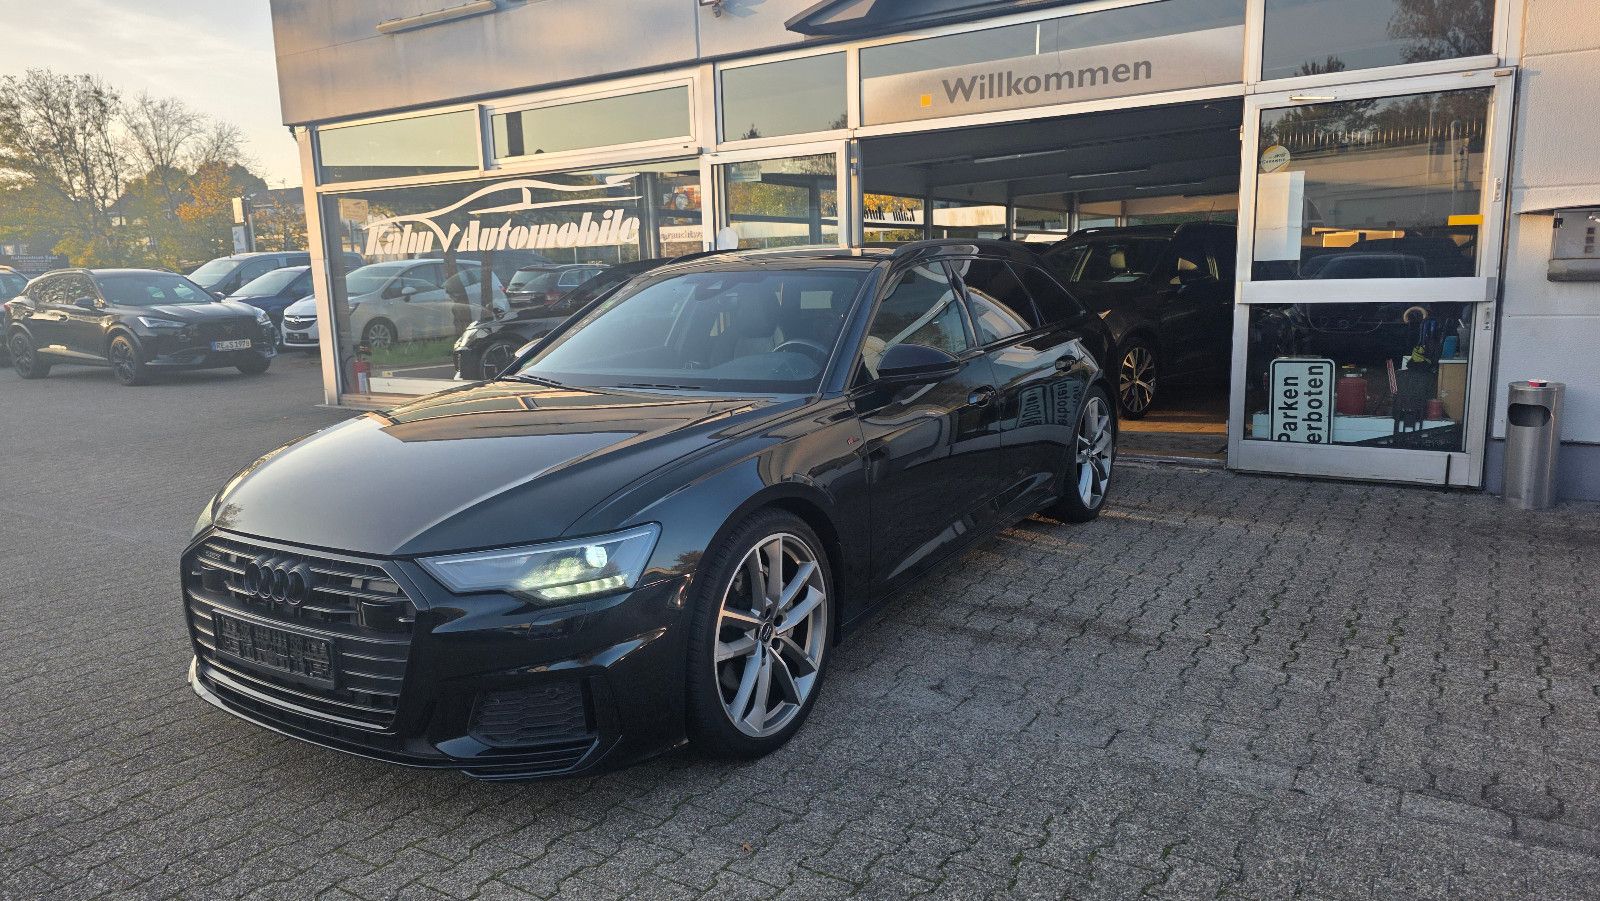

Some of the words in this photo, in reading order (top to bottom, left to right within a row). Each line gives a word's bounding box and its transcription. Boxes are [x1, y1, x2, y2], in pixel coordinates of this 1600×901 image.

[942, 60, 1152, 104] Willkommen
[457, 208, 640, 252] Automobile
[1277, 376, 1299, 441] Parken
[1302, 365, 1324, 444] erboten
